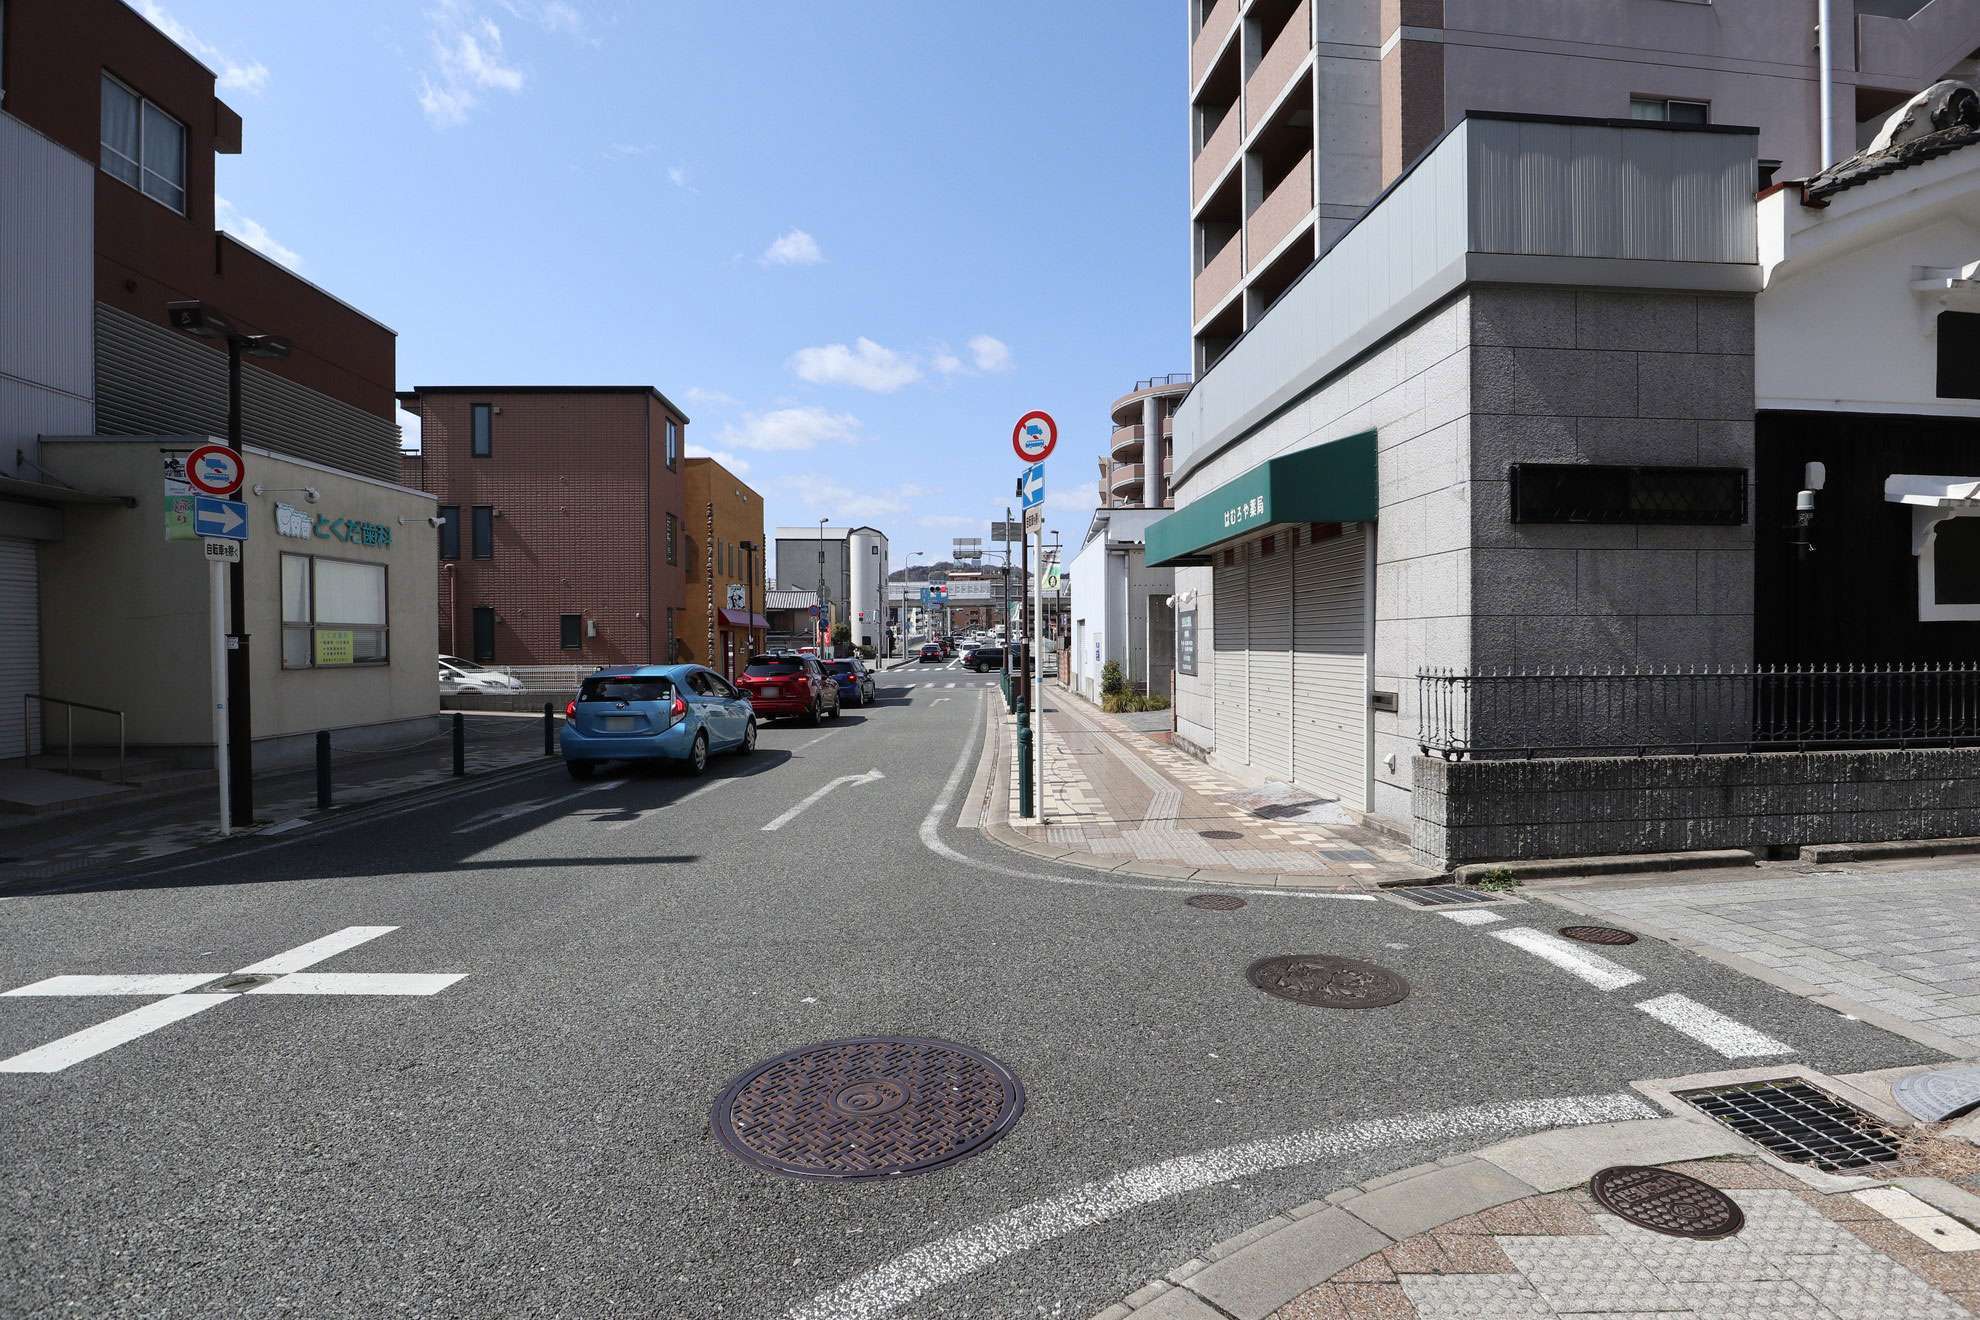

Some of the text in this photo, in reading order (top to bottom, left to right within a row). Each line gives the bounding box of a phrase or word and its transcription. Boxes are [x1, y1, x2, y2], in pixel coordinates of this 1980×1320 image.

[313, 513, 392, 547] とくだ歯科
[207, 543, 239, 557] 自転車を除く
